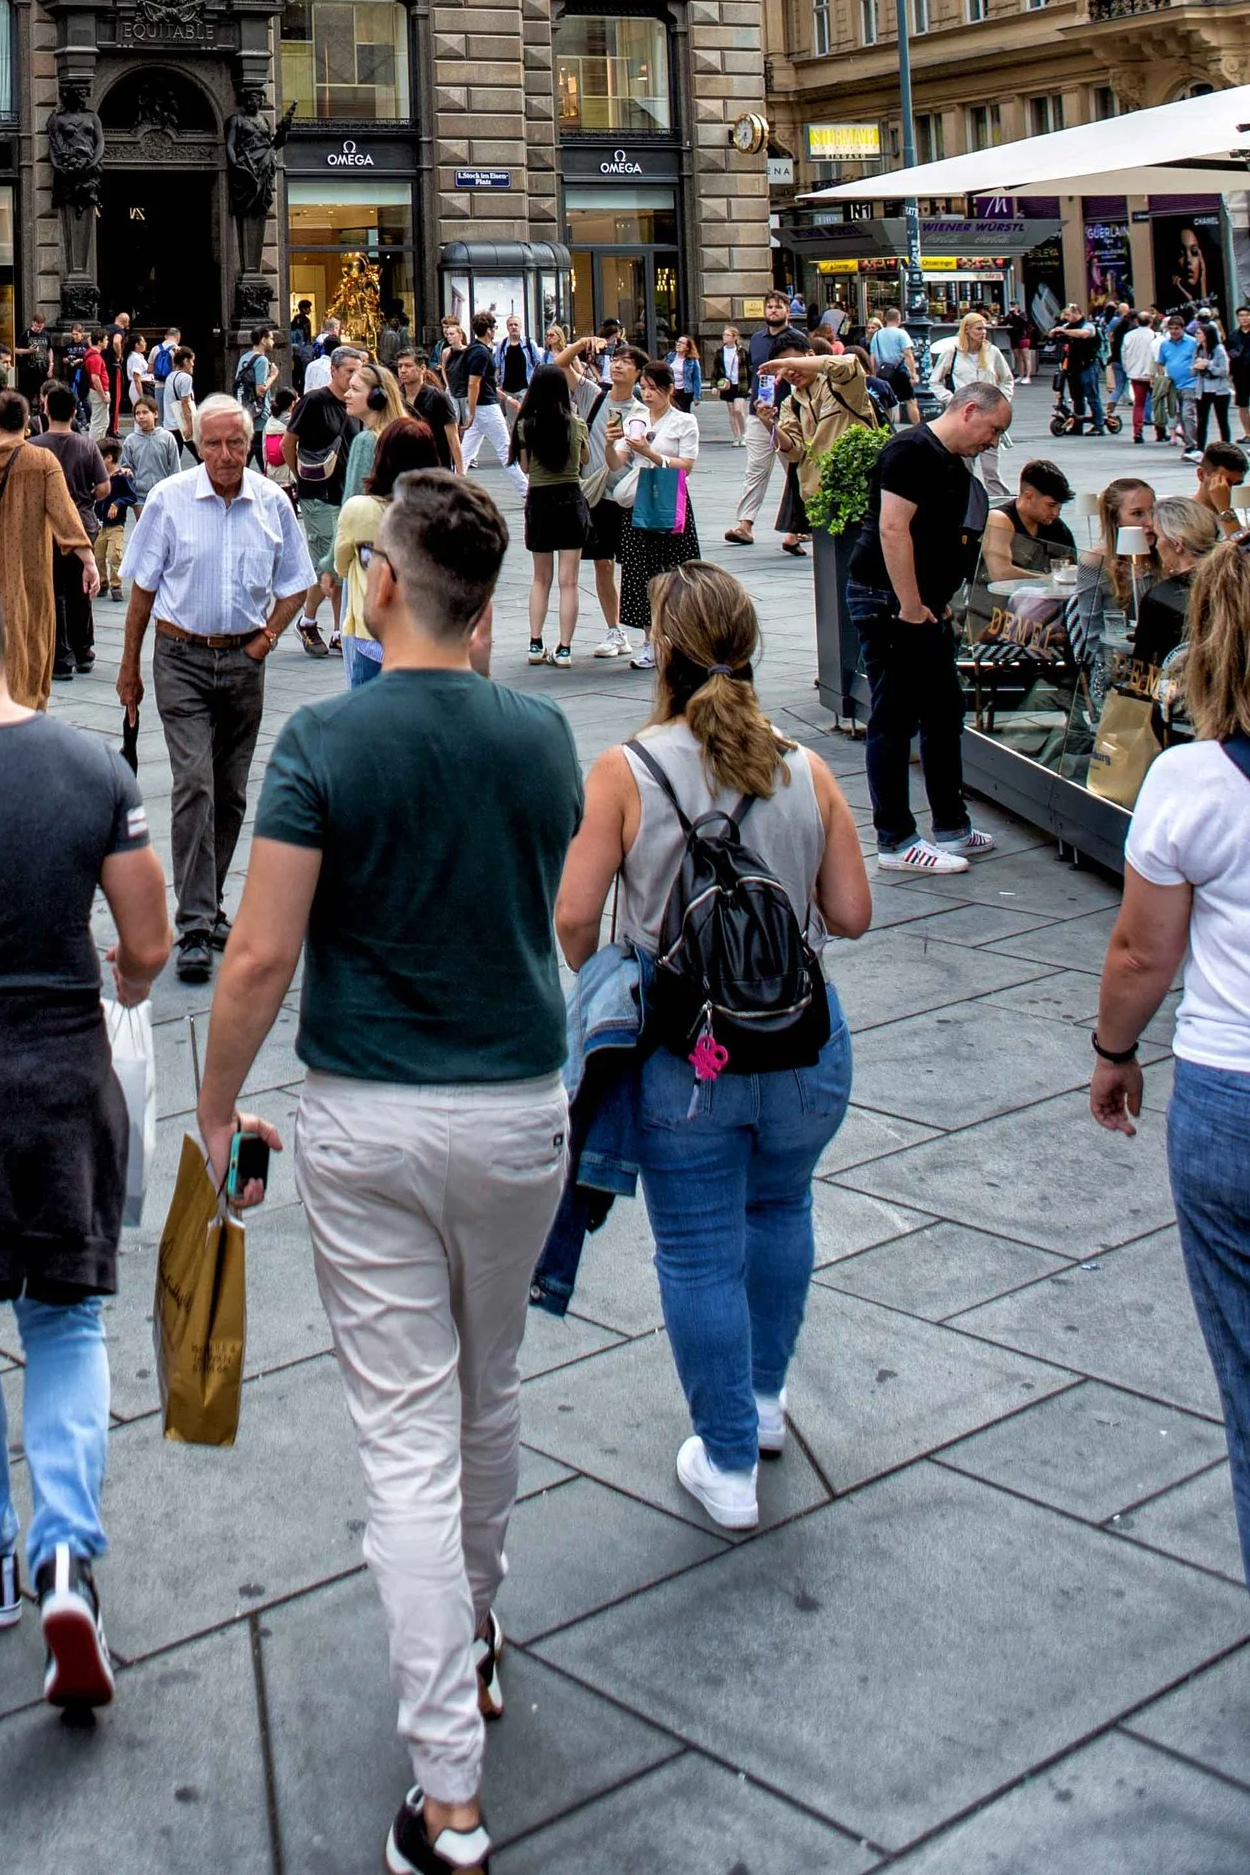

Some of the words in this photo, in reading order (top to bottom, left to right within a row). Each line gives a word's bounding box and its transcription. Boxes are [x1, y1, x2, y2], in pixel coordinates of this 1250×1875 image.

[123, 22, 215, 41] EQUITABLE
[327, 154, 374, 167] OMEGA
[600, 161, 643, 174] OMEGA
[922, 222, 971, 232] WIENER
[975, 221, 1025, 233] WÜRSTL
[1193, 216, 1219, 226] CHANEL
[1087, 225, 1129, 239] GUERLAIN
